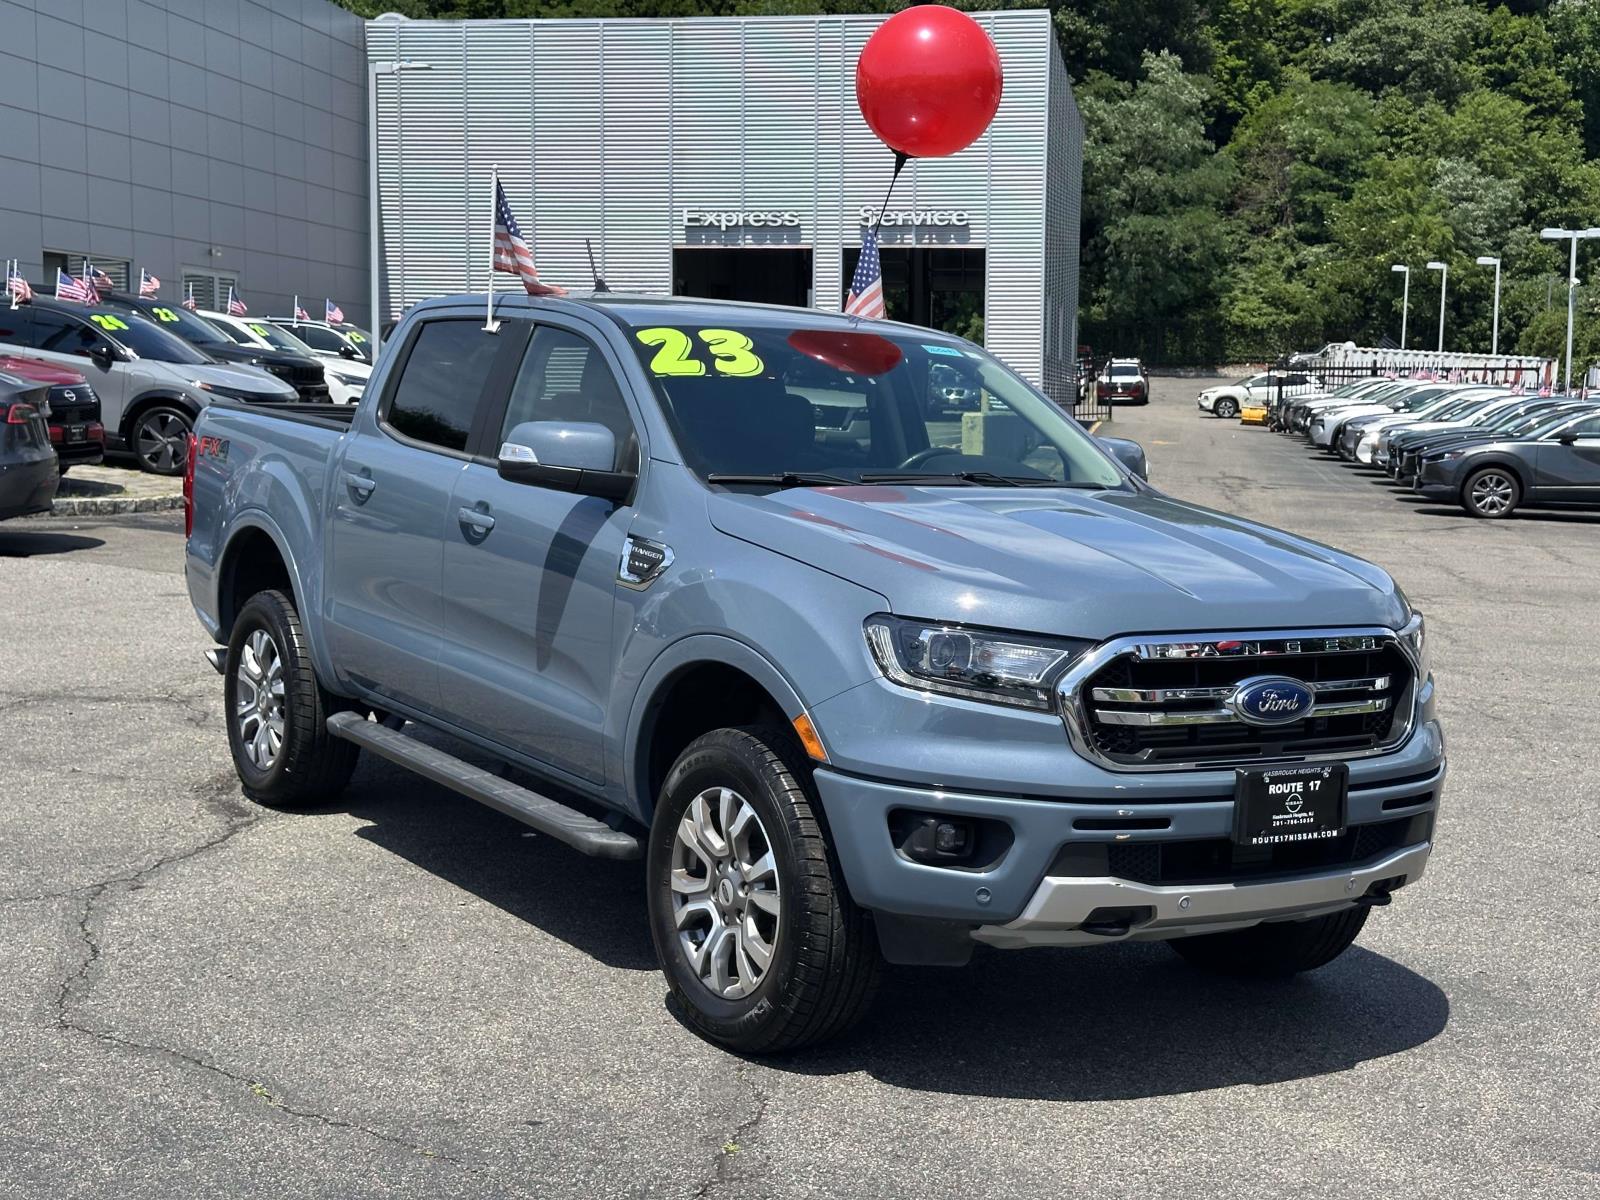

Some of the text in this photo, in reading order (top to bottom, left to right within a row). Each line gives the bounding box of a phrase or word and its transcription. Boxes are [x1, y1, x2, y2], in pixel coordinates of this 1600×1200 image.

[683, 206, 968, 231] Express Service
[636, 328, 765, 377] 23
[200, 436, 230, 463] FX4
[632, 545, 663, 560] RANGER
[1156, 637, 1376, 658] RANGER
[1258, 688, 1299, 713] Ford
[1263, 768, 1298, 778] HASBROUCK
[1268, 780, 1321, 795] ROUTE 17
[1252, 830, 1338, 845] ROUTE17NISSAN.COM
